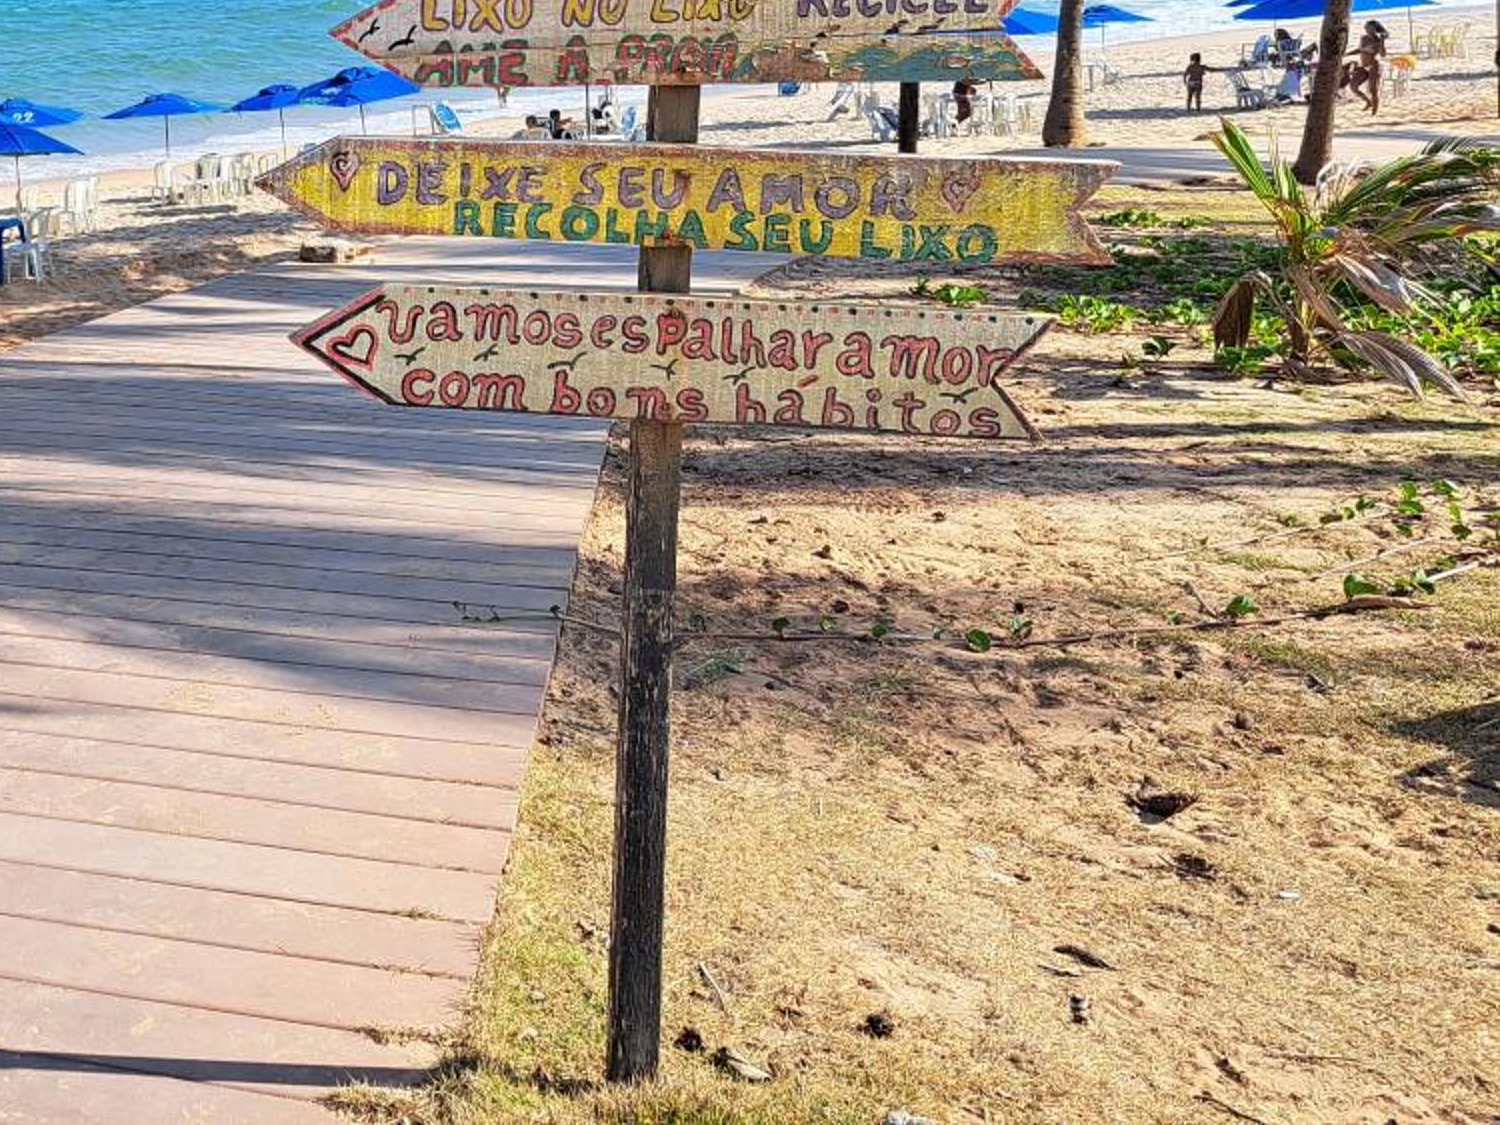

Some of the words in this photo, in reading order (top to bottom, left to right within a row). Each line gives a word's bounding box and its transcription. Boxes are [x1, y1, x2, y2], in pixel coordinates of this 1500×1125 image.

[414, 39, 530, 86] AME
[556, 35, 590, 84] A
[376, 160, 545, 206] DEIXE
[572, 163, 690, 210] SEU
[706, 166, 917, 220] AMOR
[453, 198, 709, 249] RECOLHA
[724, 210, 833, 254] SEU
[859, 218, 998, 264] LIXO
[835, 329, 1016, 388] amor
[401, 367, 528, 411] com
[550, 369, 710, 421] bons
[734, 374, 1002, 438] hábitos
